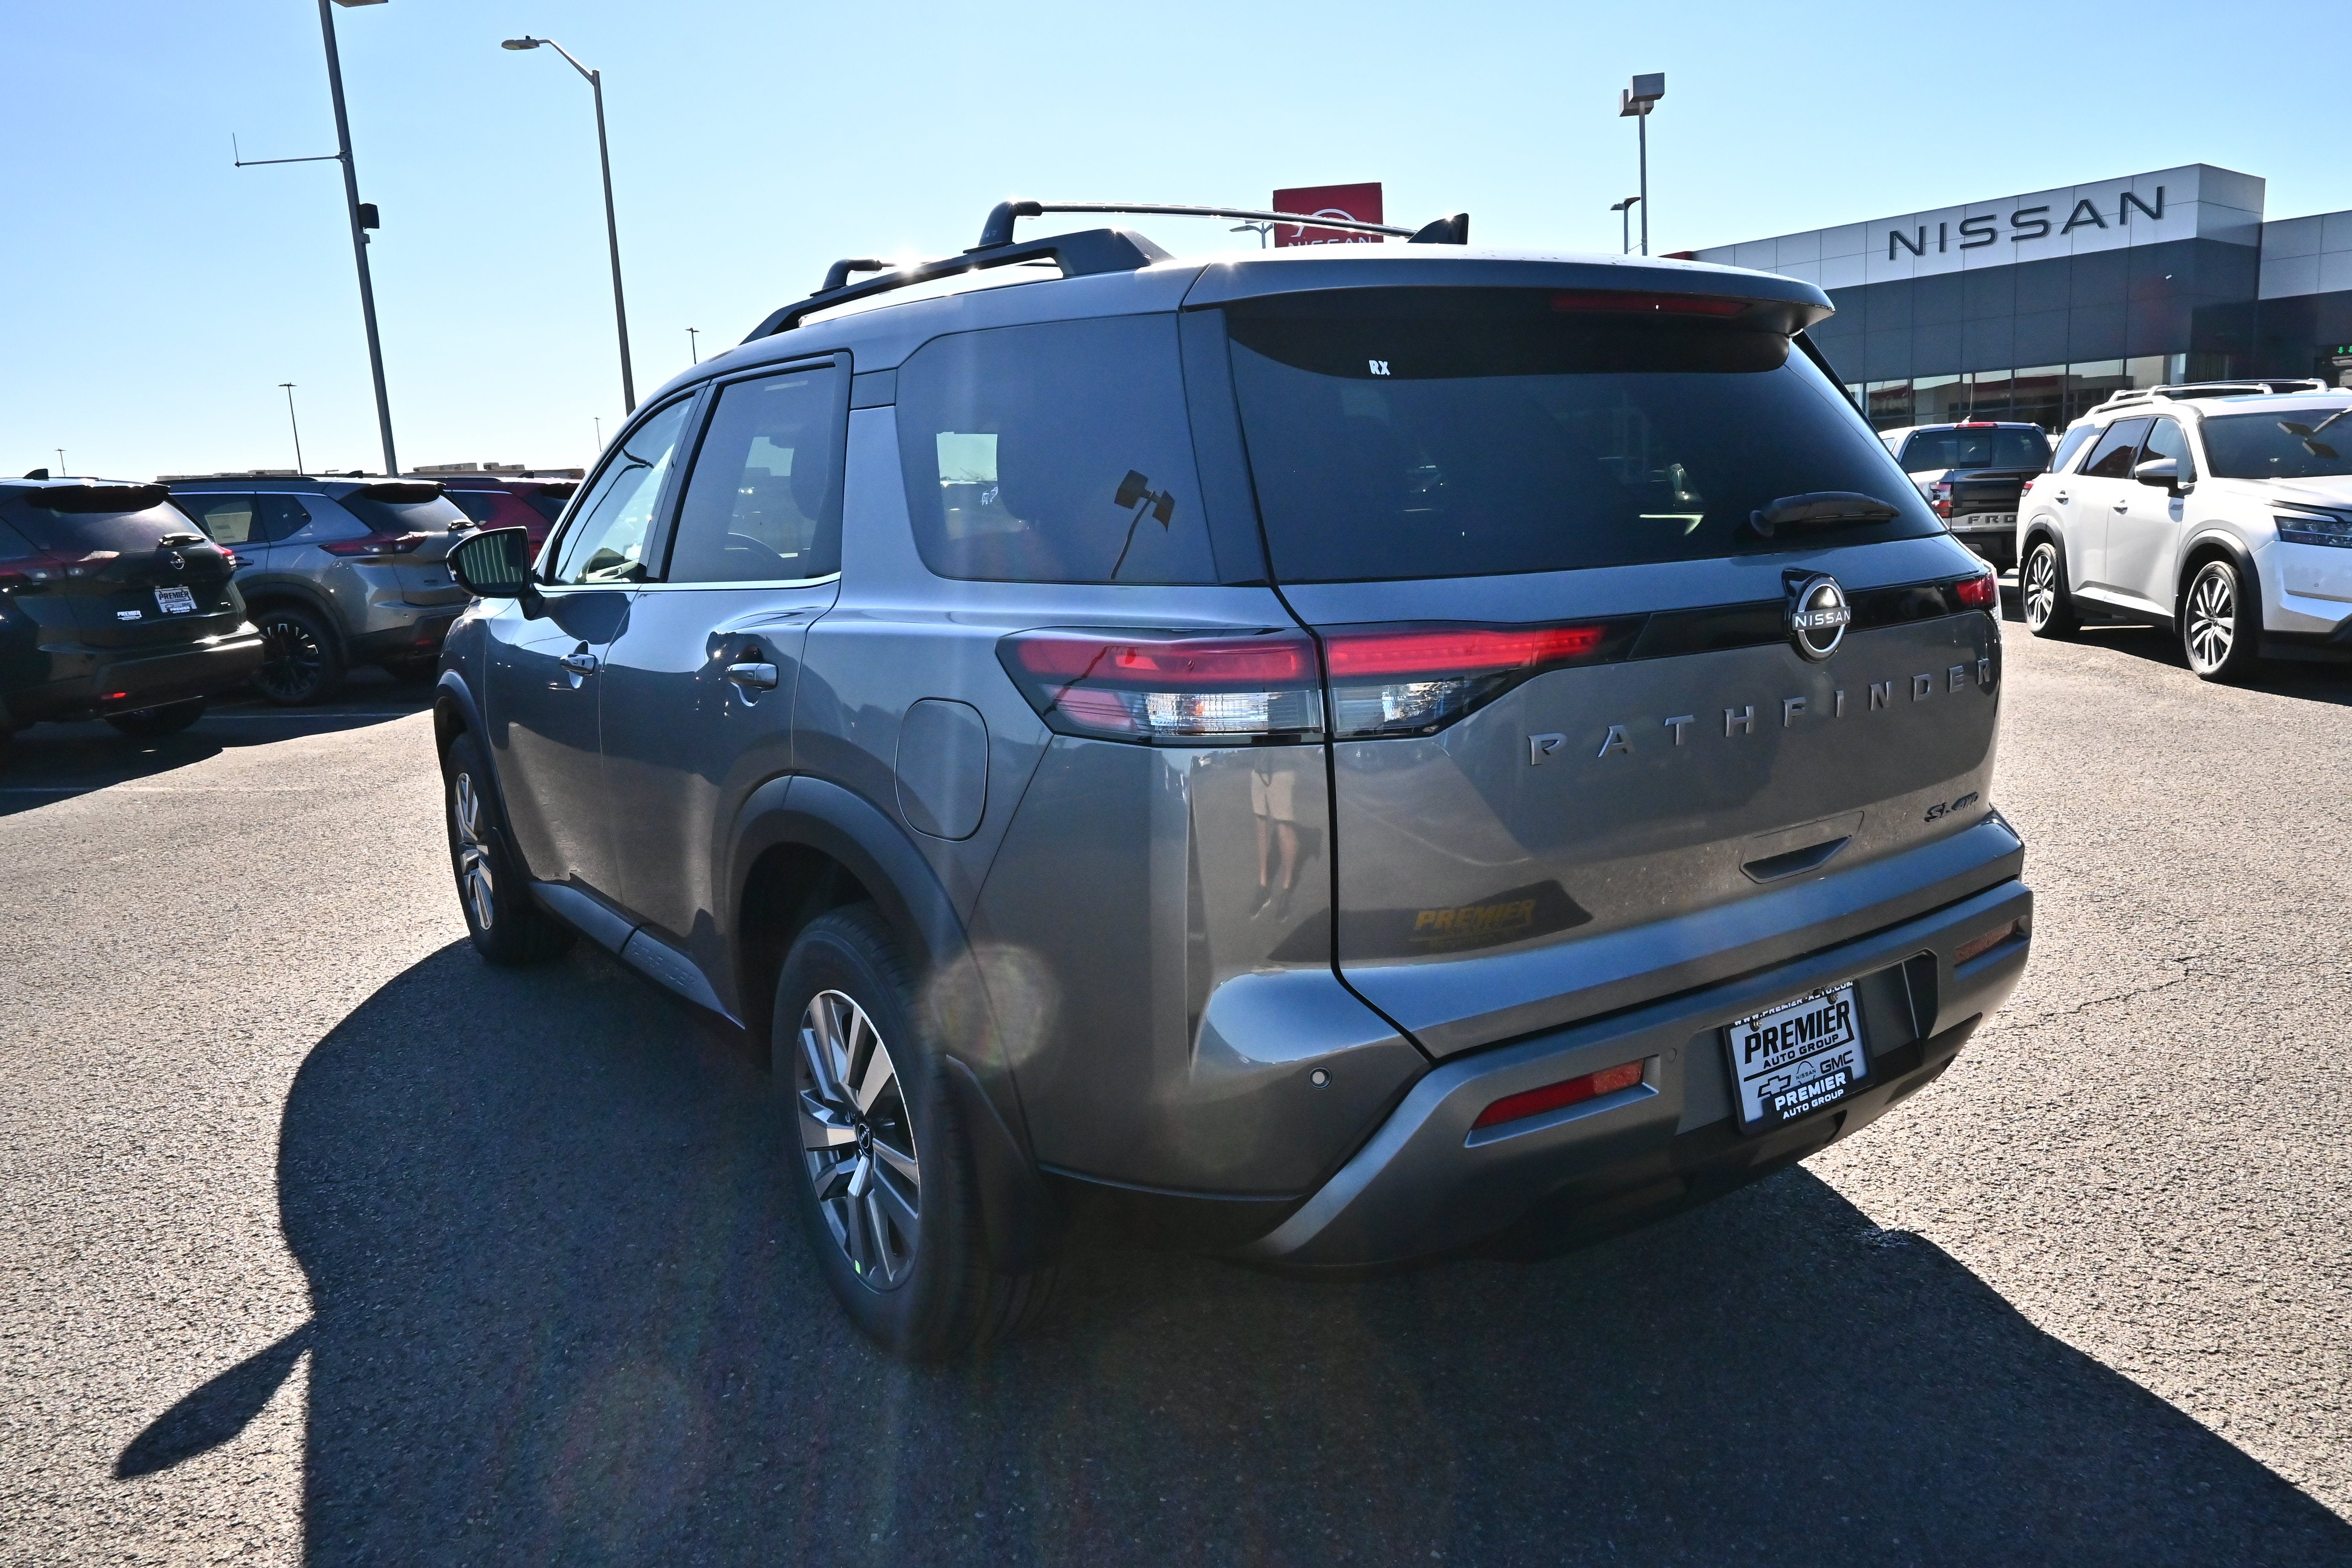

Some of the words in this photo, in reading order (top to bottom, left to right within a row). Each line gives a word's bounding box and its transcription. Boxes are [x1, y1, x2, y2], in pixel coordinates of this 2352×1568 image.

[1889, 186, 2164, 261] NISSAN
[1369, 360, 1391, 376] RX
[159, 591, 191, 600] PREMIER
[1795, 610, 1850, 627] NISSAN
[1527, 657, 1992, 766] PATHFINDER
[1414, 898, 1536, 931] PREMIER
[1745, 1000, 1855, 1064] PREMIER
[1764, 1050, 1795, 1069] AUTO
[1799, 1033, 1839, 1055] GROUP
[1820, 1050, 1854, 1074] GMC
[1796, 1068, 1816, 1080] NISSAN
[1775, 1072, 1846, 1111] PREMIER
[1783, 1103, 1809, 1120] AUTO
[1811, 1089, 1844, 1108] GROUP
